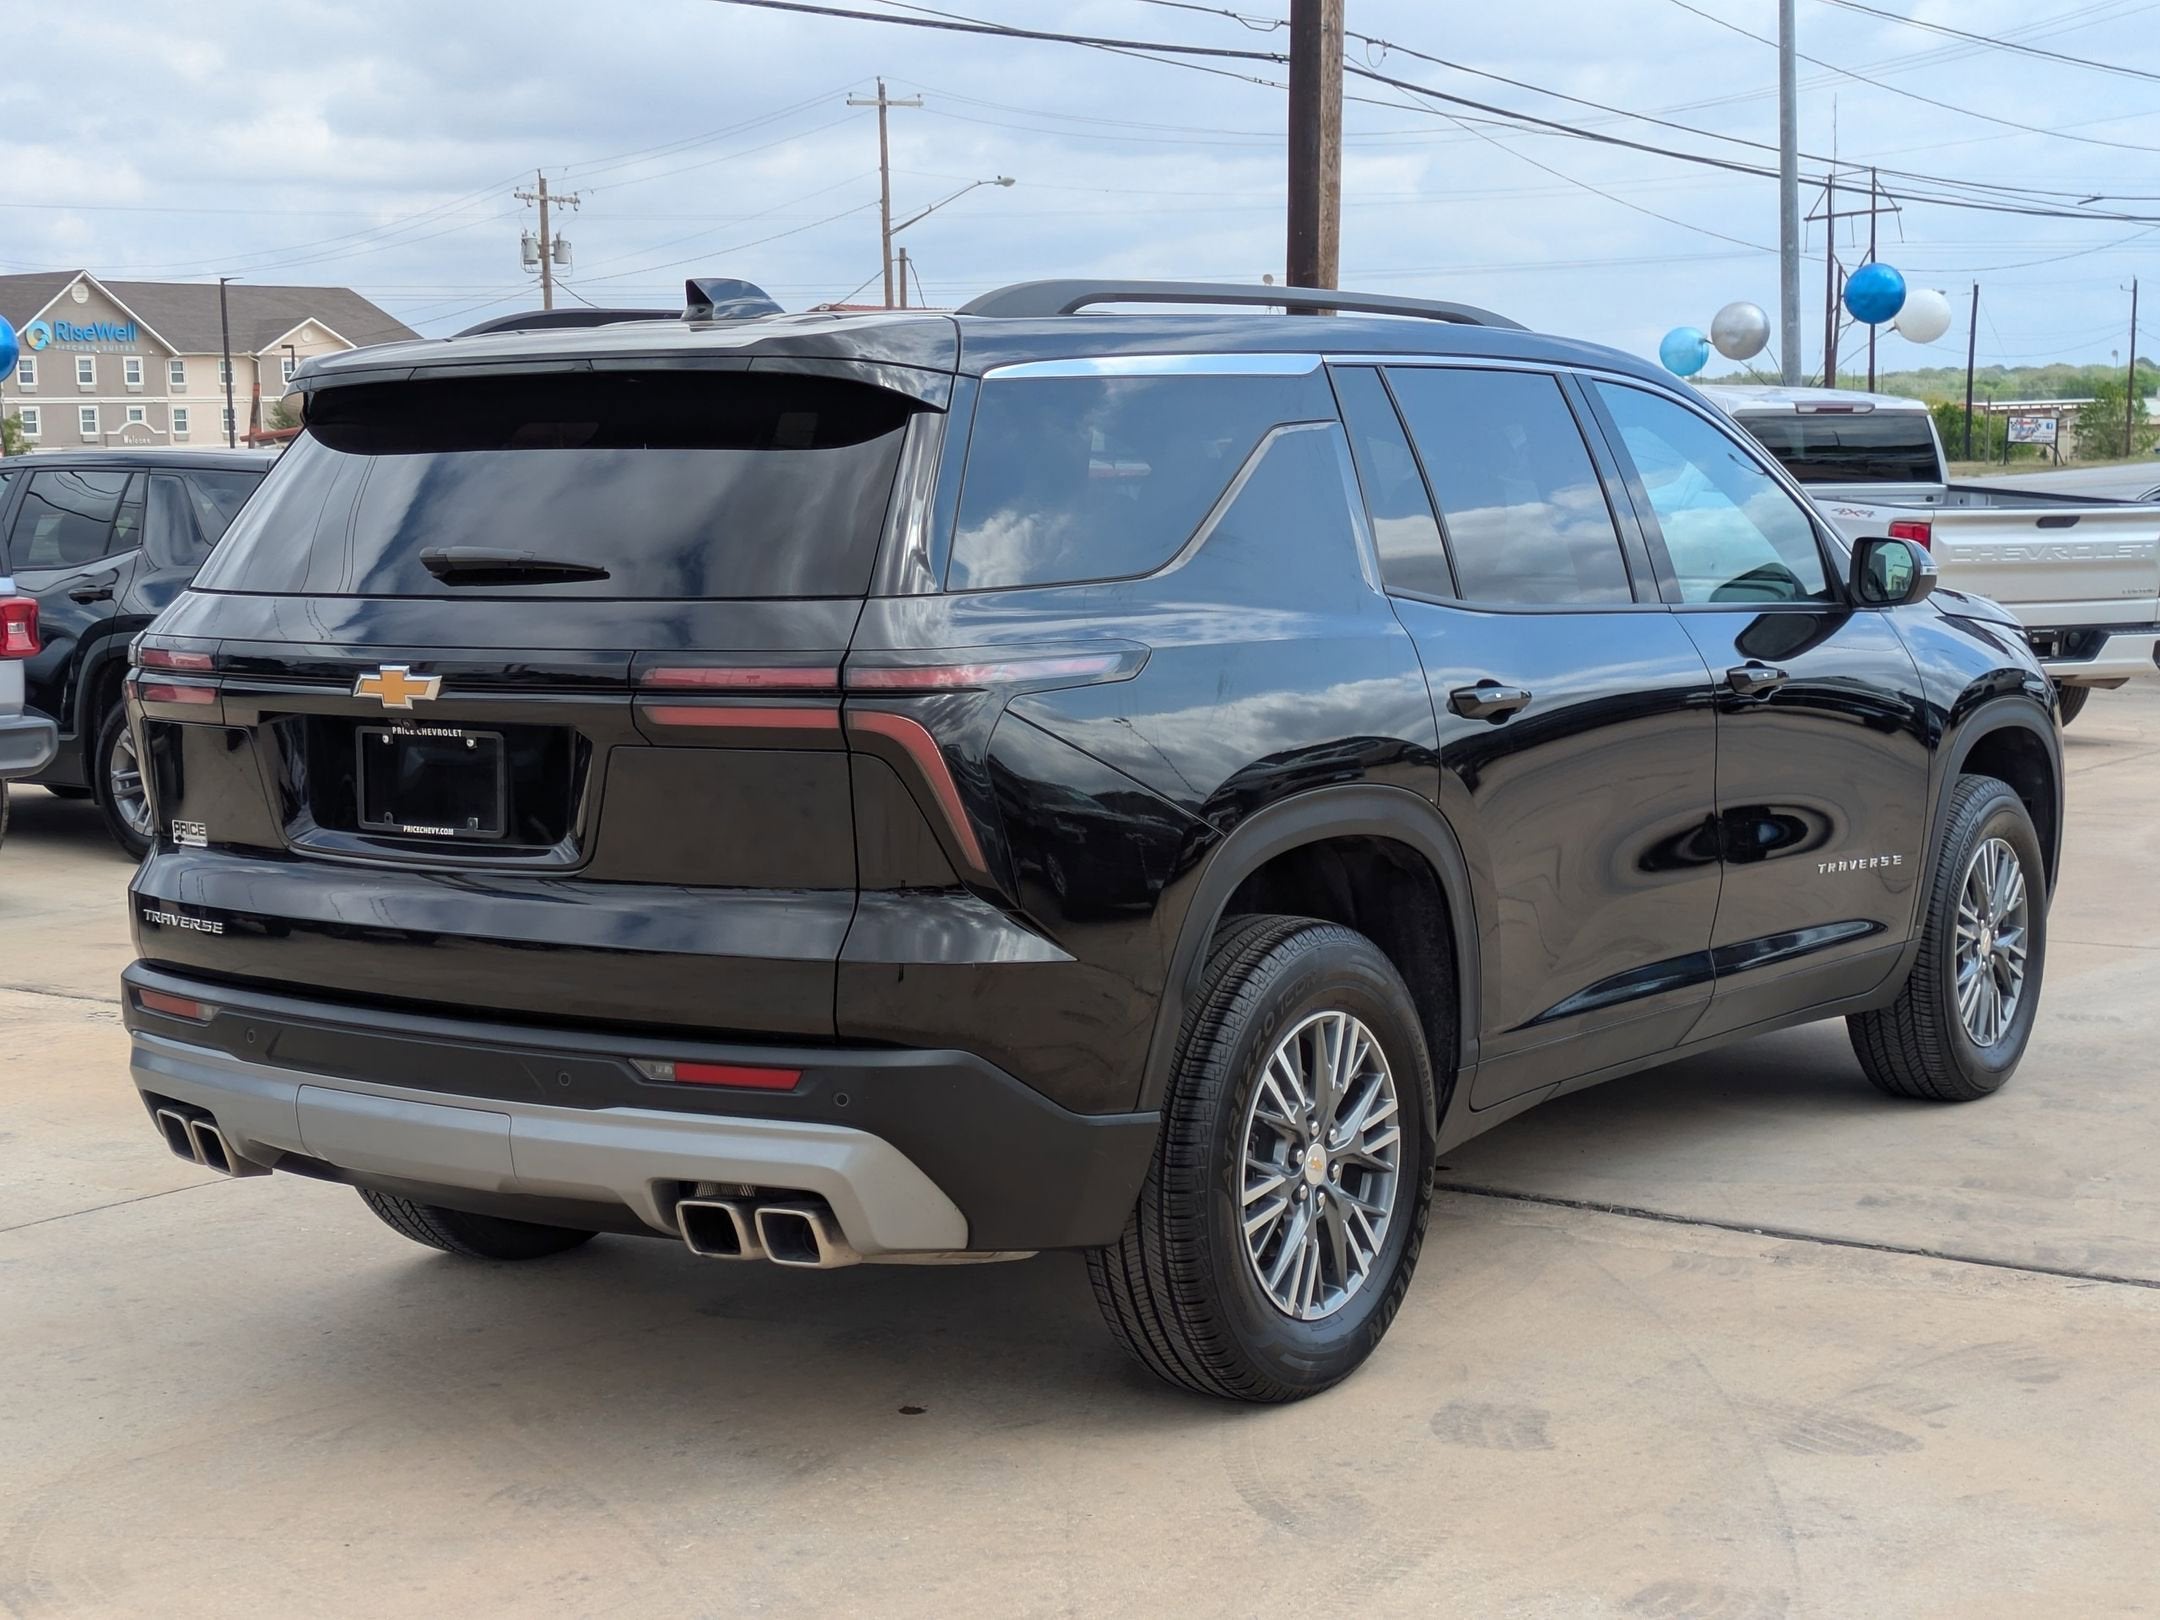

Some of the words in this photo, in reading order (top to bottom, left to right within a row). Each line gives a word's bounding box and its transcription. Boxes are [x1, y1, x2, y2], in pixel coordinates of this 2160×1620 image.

[54, 320, 137, 342] RiseWell
[102, 344, 136, 352] SUITES
[1949, 544, 2155, 562] CHEVROLET
[416, 728, 462, 737] CHEVROLET
[173, 821, 206, 837] PRICE
[1817, 855, 1903, 874] TRAVERSE
[143, 908, 224, 935] TRAVERSE
[1367, 1207, 1431, 1347] SAILUN
